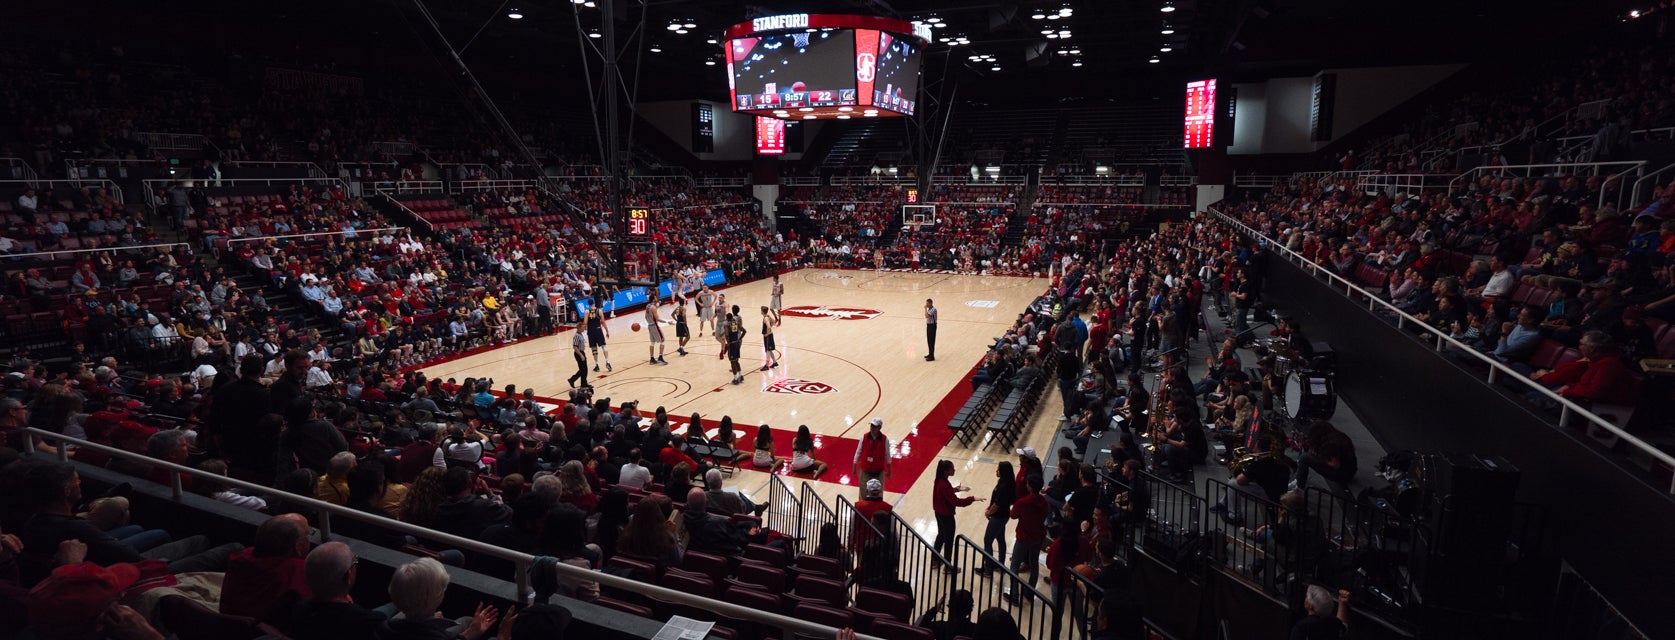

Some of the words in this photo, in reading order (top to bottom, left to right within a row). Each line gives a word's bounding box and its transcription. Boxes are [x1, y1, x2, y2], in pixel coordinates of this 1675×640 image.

[753, 14, 809, 32] STANFORD
[759, 94, 773, 104] 15
[785, 92, 805, 102] 8:57
[818, 91, 832, 101] 22
[907, 195, 917, 203] 30
[631, 209, 648, 219] 8:57
[630, 219, 646, 235] 30
